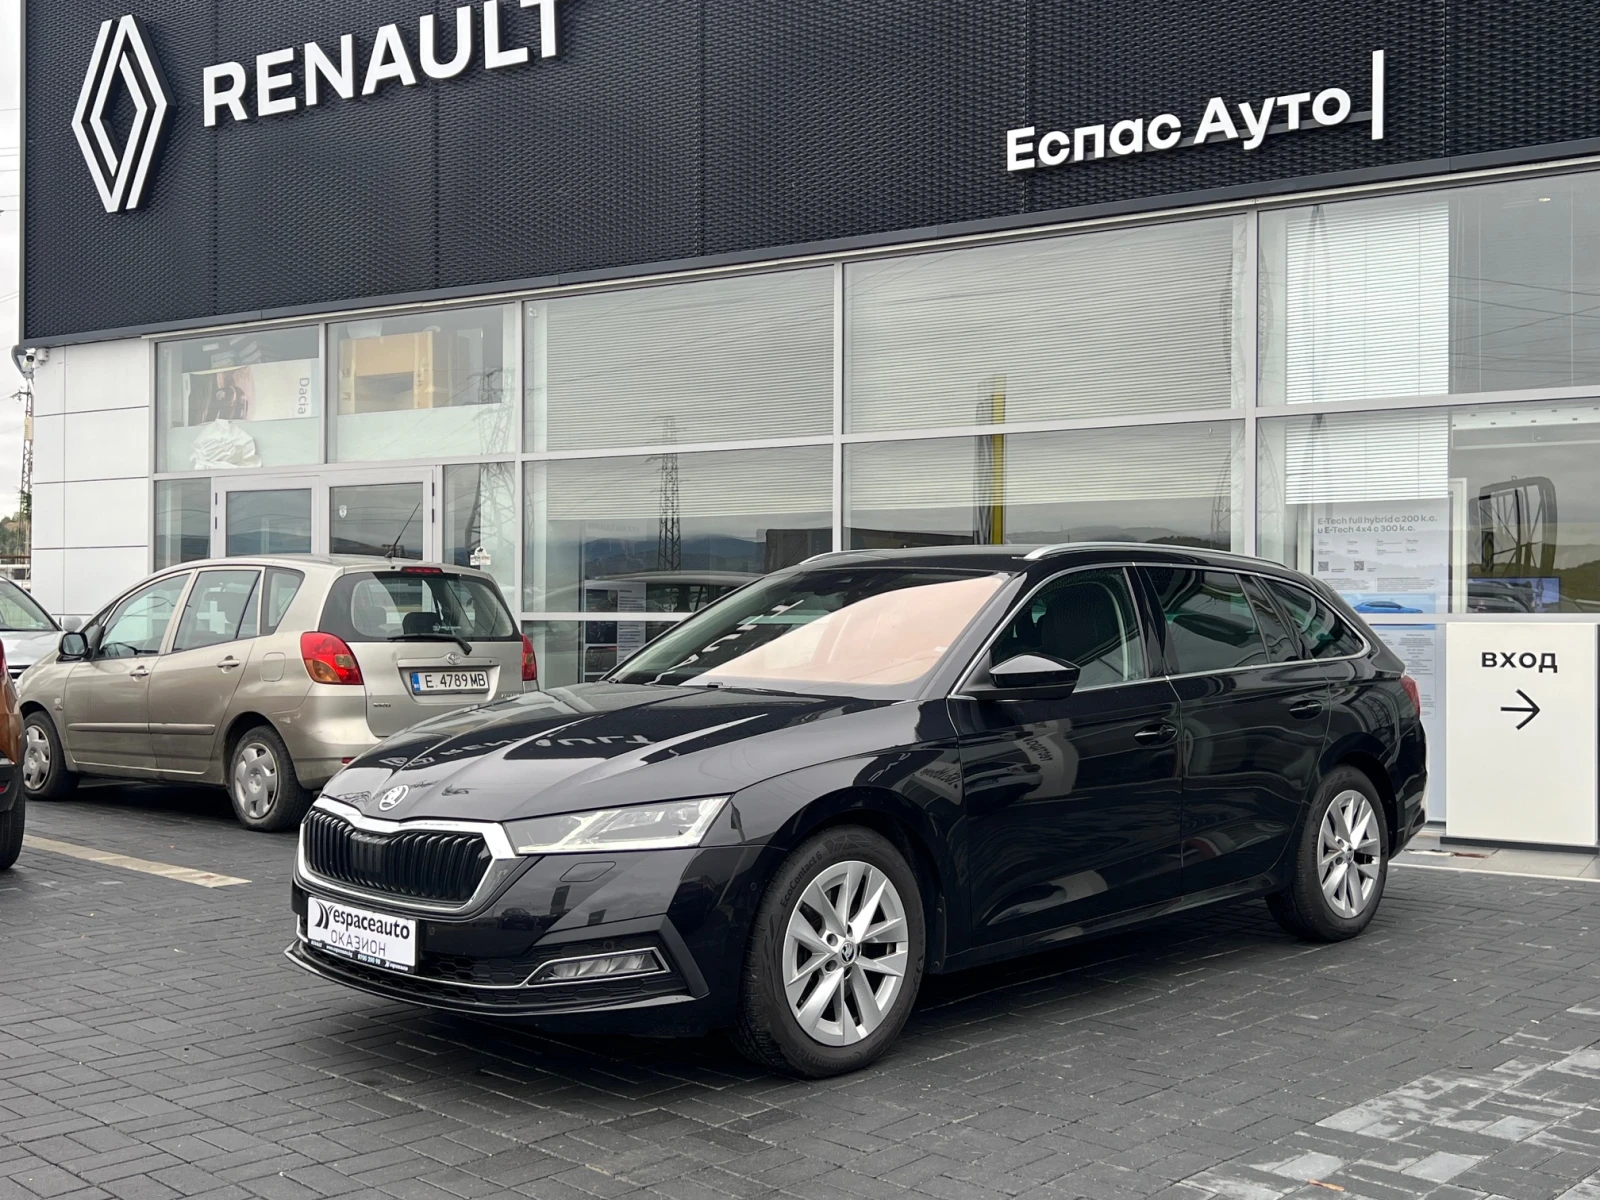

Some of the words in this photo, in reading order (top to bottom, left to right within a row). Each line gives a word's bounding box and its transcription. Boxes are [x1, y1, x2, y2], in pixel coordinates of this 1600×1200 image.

[202, 0, 561, 128] RENAULT
[1006, 112, 1182, 172] Еспас
[1193, 87, 1351, 151] Ауто
[297, 377, 310, 415] Dacia
[1324, 526, 1354, 534] E-Tech
[1380, 524, 1398, 532] 300
[1348, 516, 1363, 524] full
[1364, 515, 1393, 526] hybrid
[1401, 514, 1420, 523] 200
[779, 855, 817, 908] EcoContact
[333, 908, 410, 940] espaceauto
[330, 929, 387, 958] ОКАЗИОН
